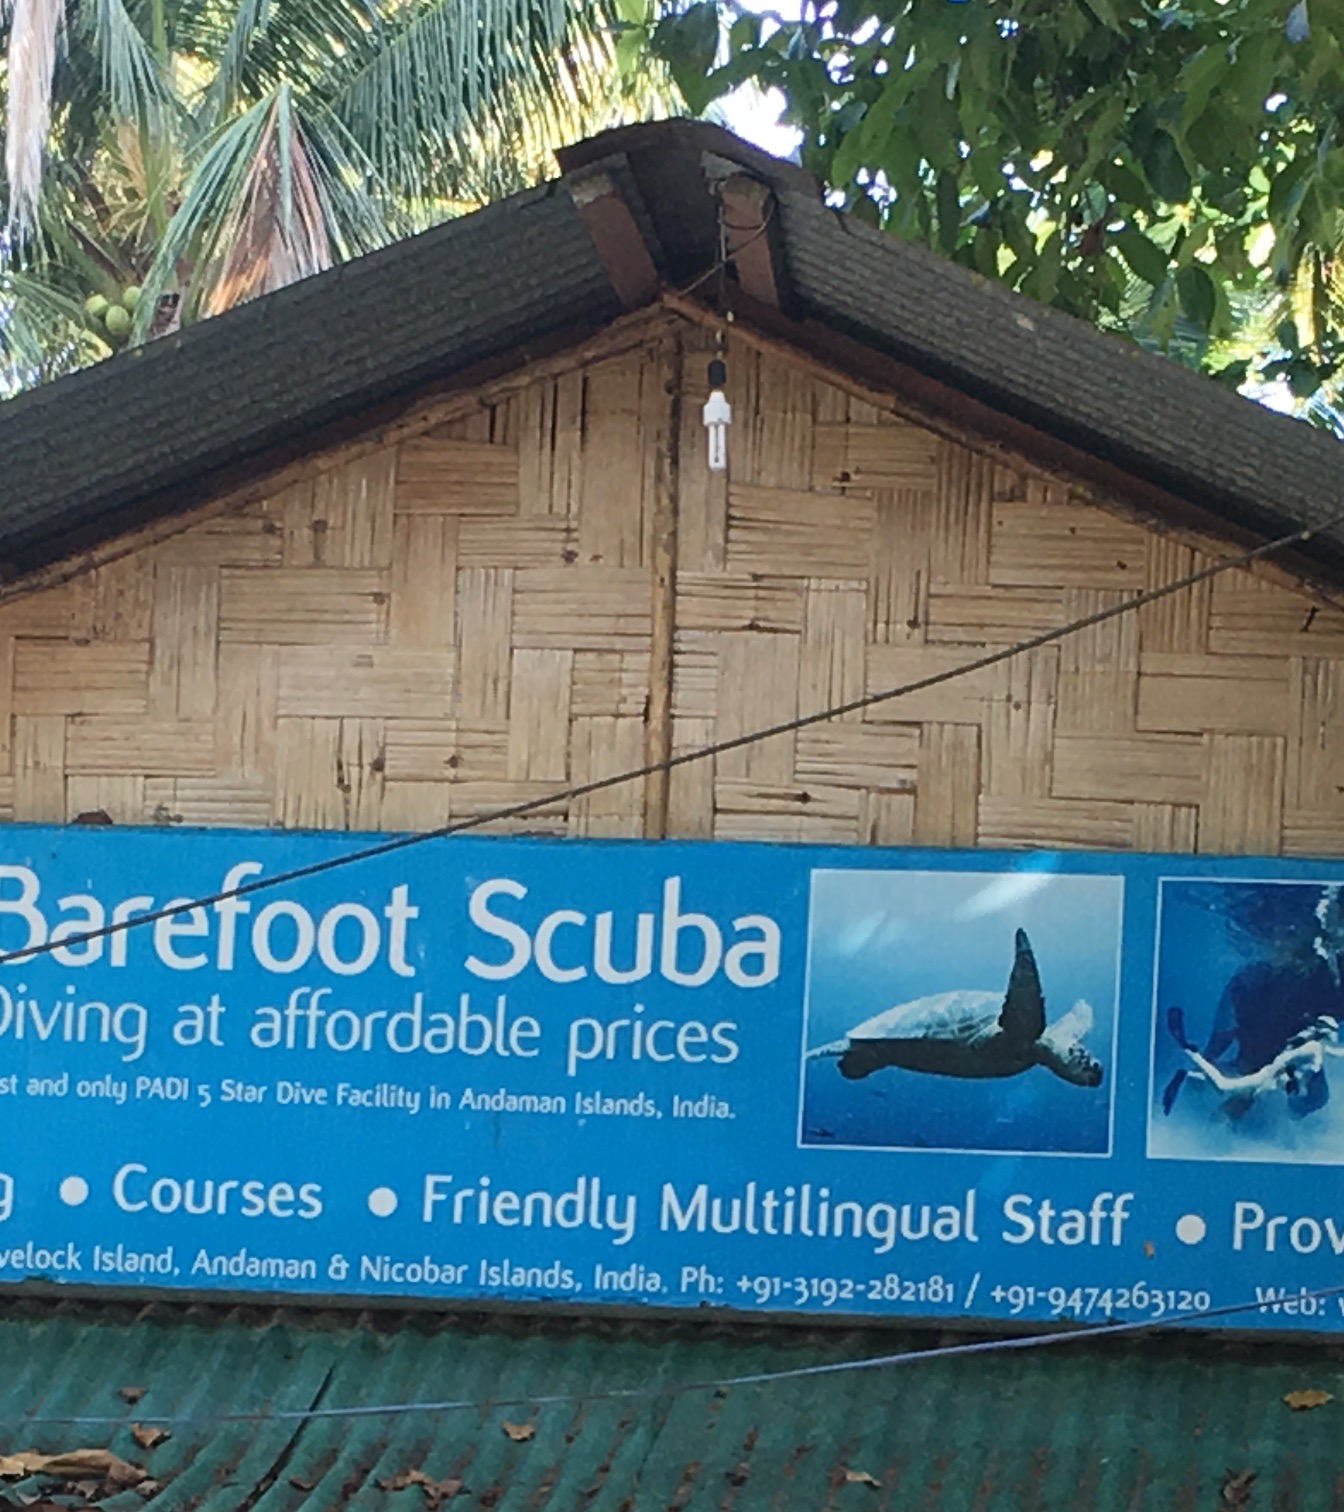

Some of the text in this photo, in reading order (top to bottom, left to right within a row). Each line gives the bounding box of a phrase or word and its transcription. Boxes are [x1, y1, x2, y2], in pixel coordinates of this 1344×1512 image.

[464, 876, 781, 987] Scuba
[172, 993, 227, 1047] at
[250, 986, 541, 1057] affordable
[567, 1003, 739, 1077] prices
[26, 1072, 69, 1097] and
[76, 1075, 128, 1105] only
[136, 1077, 189, 1101] PADI
[198, 1085, 211, 1108] 5
[220, 1079, 268, 1103] Star
[276, 1081, 328, 1106] Dive
[337, 1082, 420, 1115] Facility
[458, 1087, 566, 1115] Andaman
[574, 1091, 663, 1119] Islands,
[672, 1094, 736, 1119] India.
[112, 1162, 324, 1219] Courses
[422, 1174, 1135, 1254] Friendly Multilingual Staff
[92, 1244, 180, 1276] Island,
[191, 1247, 317, 1280] Andaman
[327, 1252, 349, 1281] &
[359, 1254, 468, 1286] Nicobar
[478, 1258, 582, 1292] Islands,
[680, 1265, 724, 1295] Ph:
[736, 1272, 954, 1307] +91-3192-282181
[964, 1272, 982, 1310] /
[990, 1281, 1212, 1317] +91-9474263120
[1255, 1286, 1326, 1317] Web:
